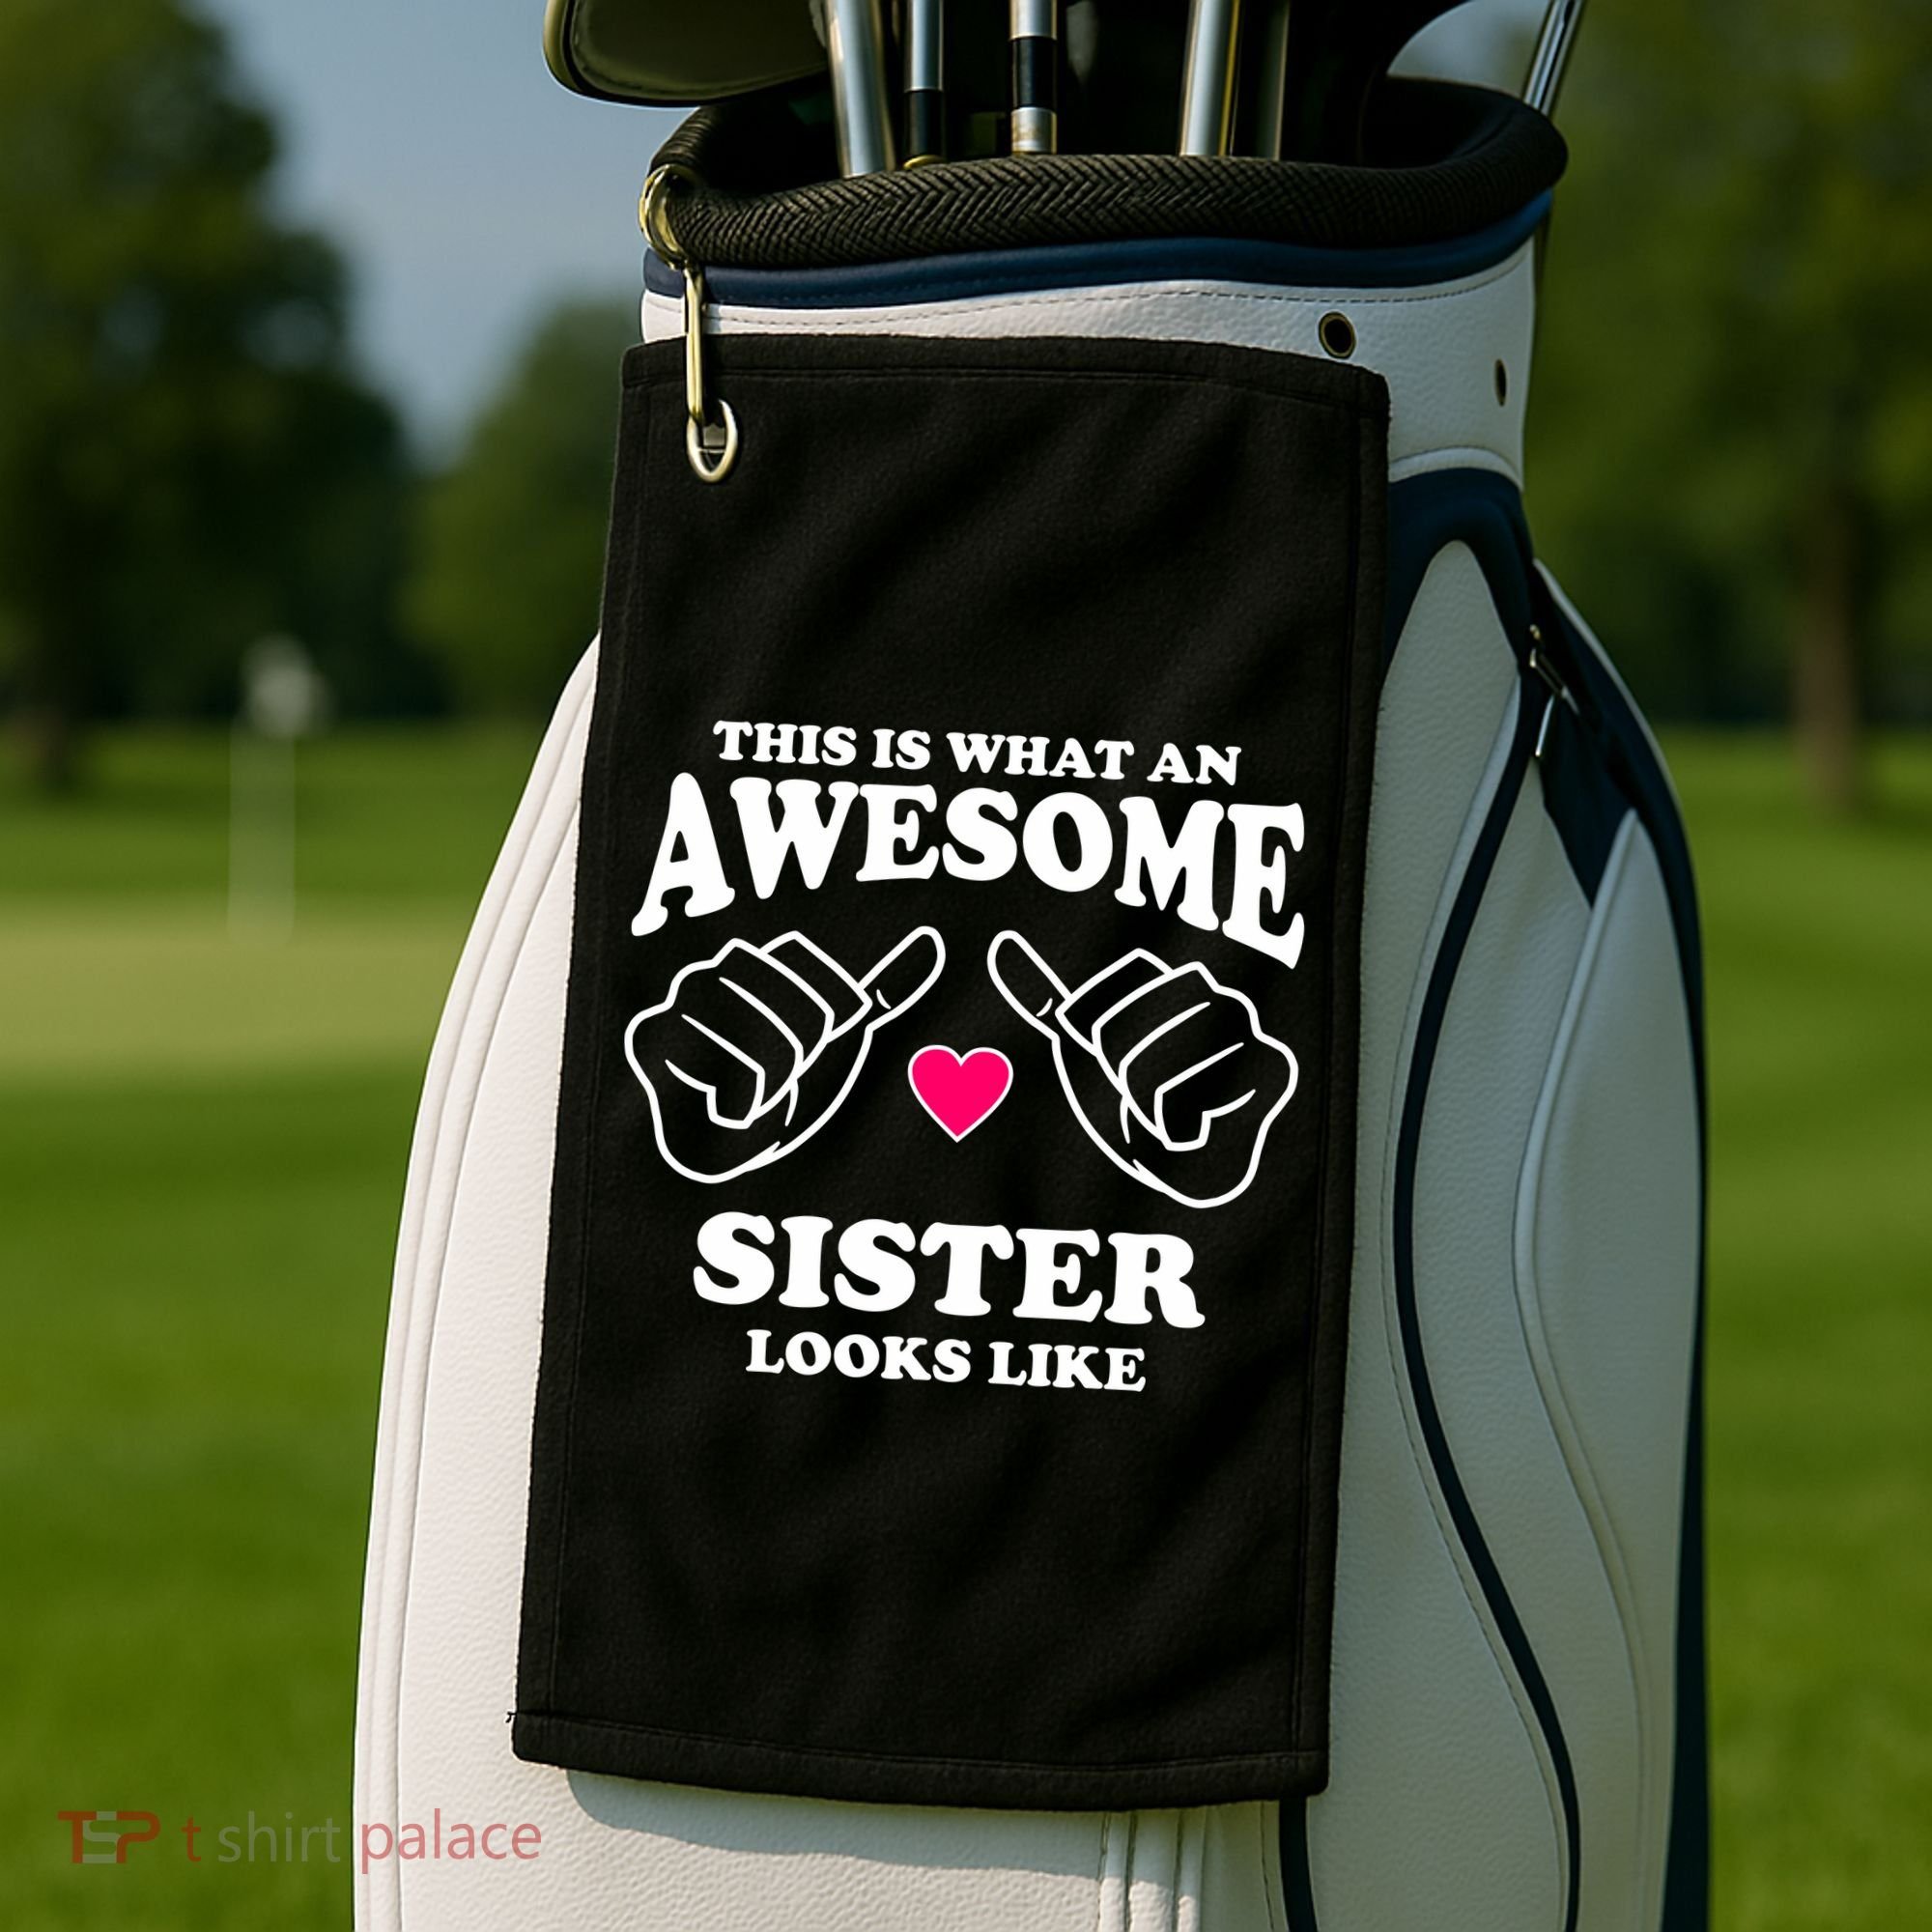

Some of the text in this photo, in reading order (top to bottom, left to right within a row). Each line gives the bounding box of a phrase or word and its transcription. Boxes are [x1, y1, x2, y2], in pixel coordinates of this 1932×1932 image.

[713, 721, 1242, 786] THIS IS WHAT AN
[631, 773, 1305, 970] AWESOME
[694, 1212, 1206, 1330] SISTER
[746, 1329, 1147, 1392] LOOKS LIKE
